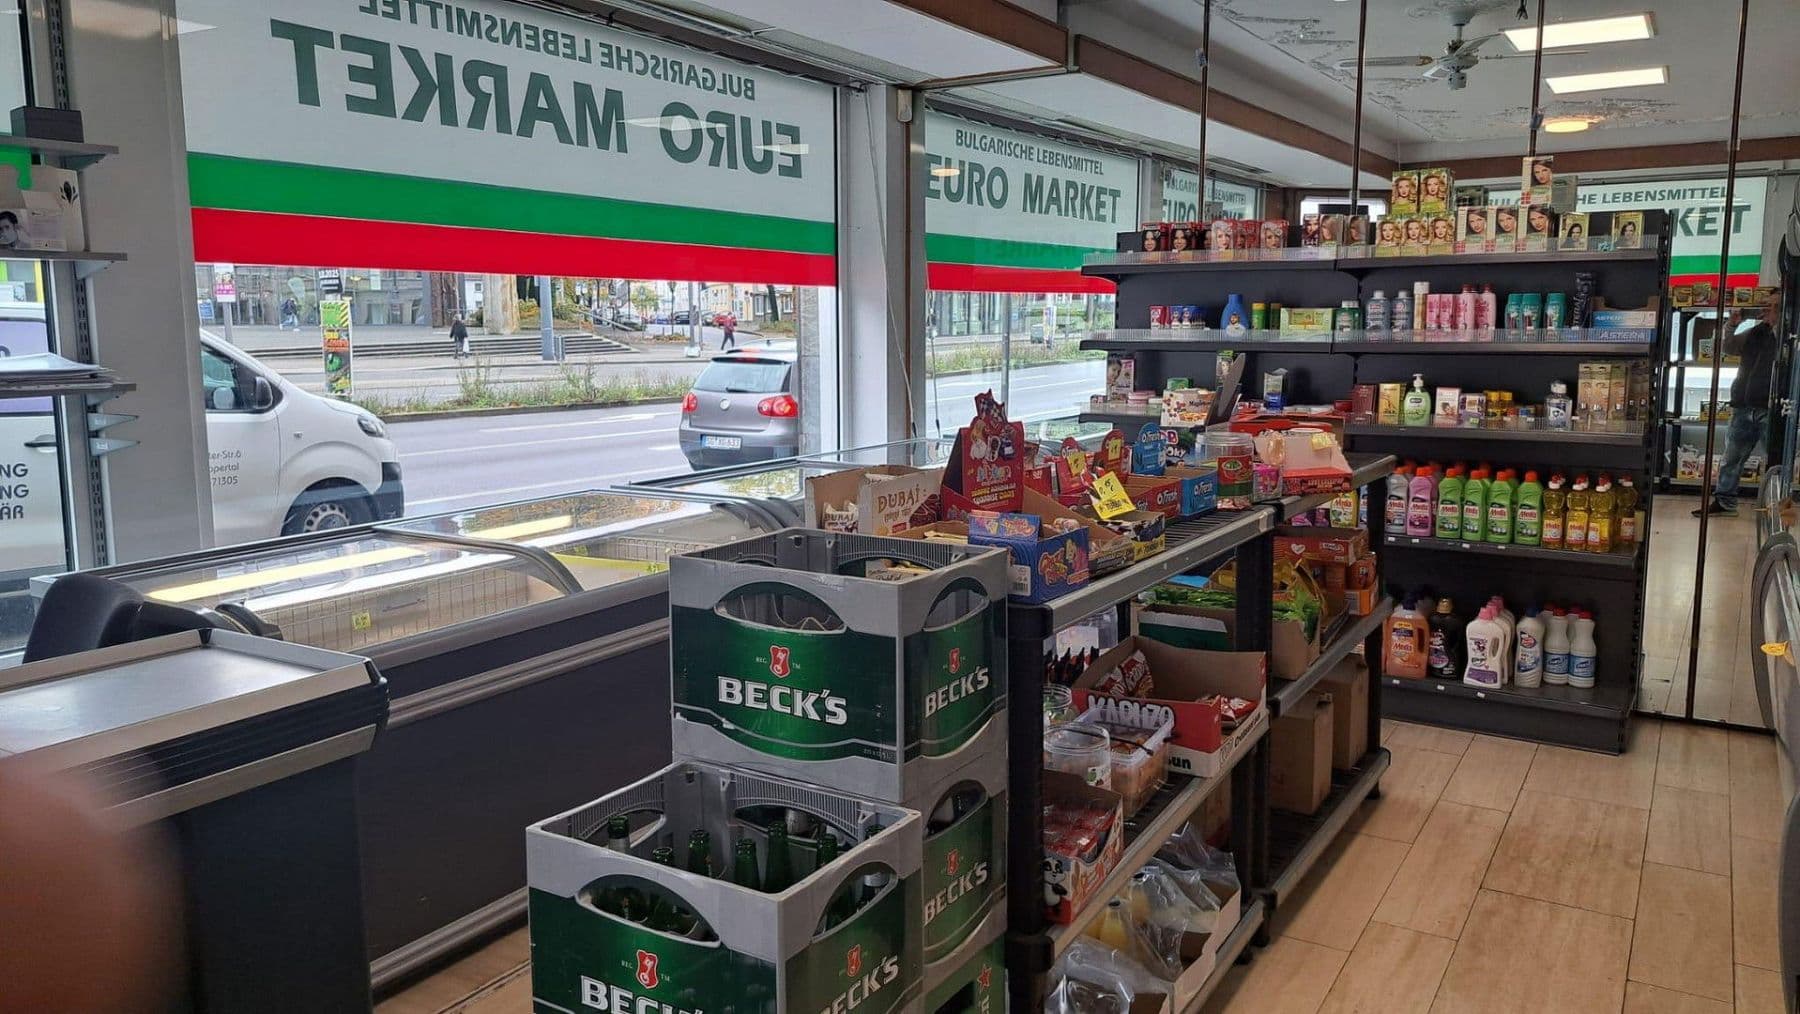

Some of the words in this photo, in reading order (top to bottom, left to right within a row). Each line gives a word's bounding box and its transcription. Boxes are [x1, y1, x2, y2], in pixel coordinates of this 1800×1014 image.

[955, 128, 1034, 161] BULGARISCHE
[1036, 147, 1104, 176] LEBENSMITTEL
[925, 153, 1009, 210] EURO
[1022, 172, 1121, 225] MARKET
[1600, 186, 1728, 205] LEBENSMITTEL
[1673, 204, 1752, 237] KET
[717, 676, 848, 726] BECK'S
[924, 665, 989, 719] BECK'S
[924, 860, 988, 927] BECK'S
